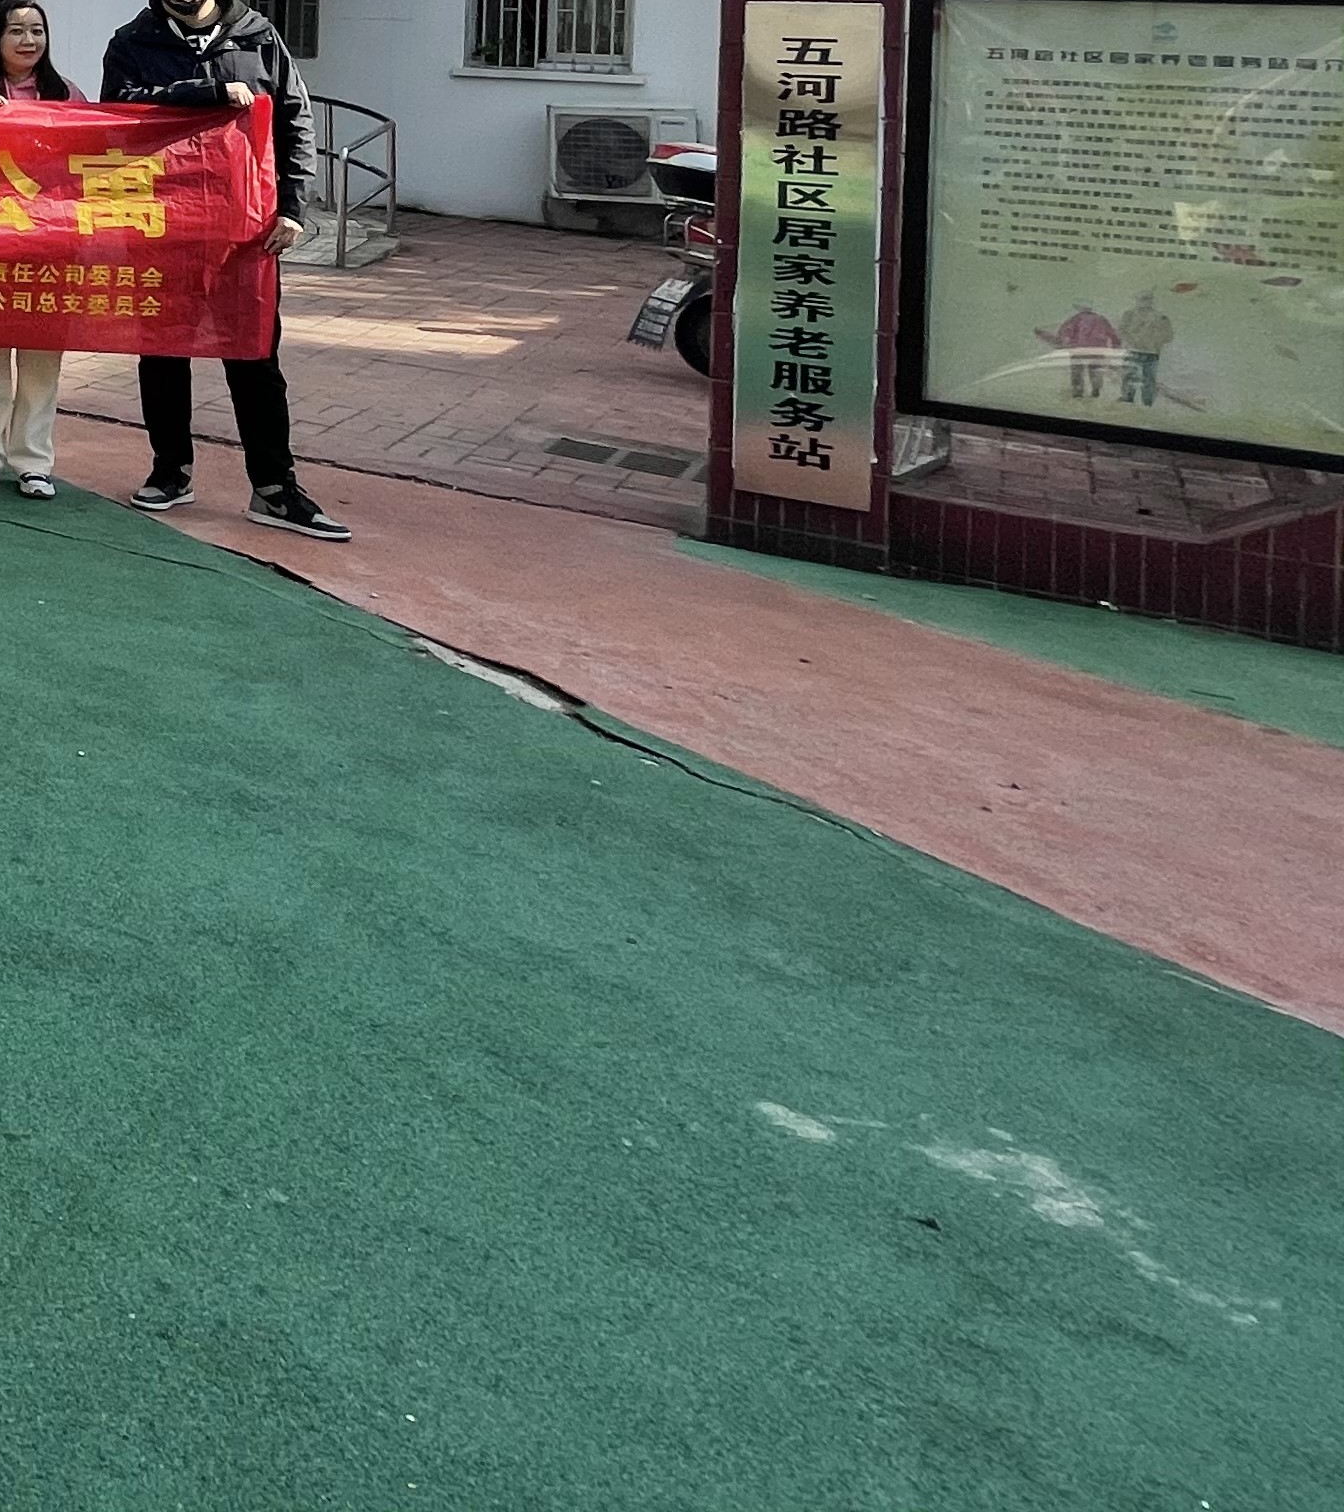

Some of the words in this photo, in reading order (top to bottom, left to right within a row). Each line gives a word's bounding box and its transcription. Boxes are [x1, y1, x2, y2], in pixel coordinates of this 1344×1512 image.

[769, 37, 843, 471] 五河路社区居家养老服务站
